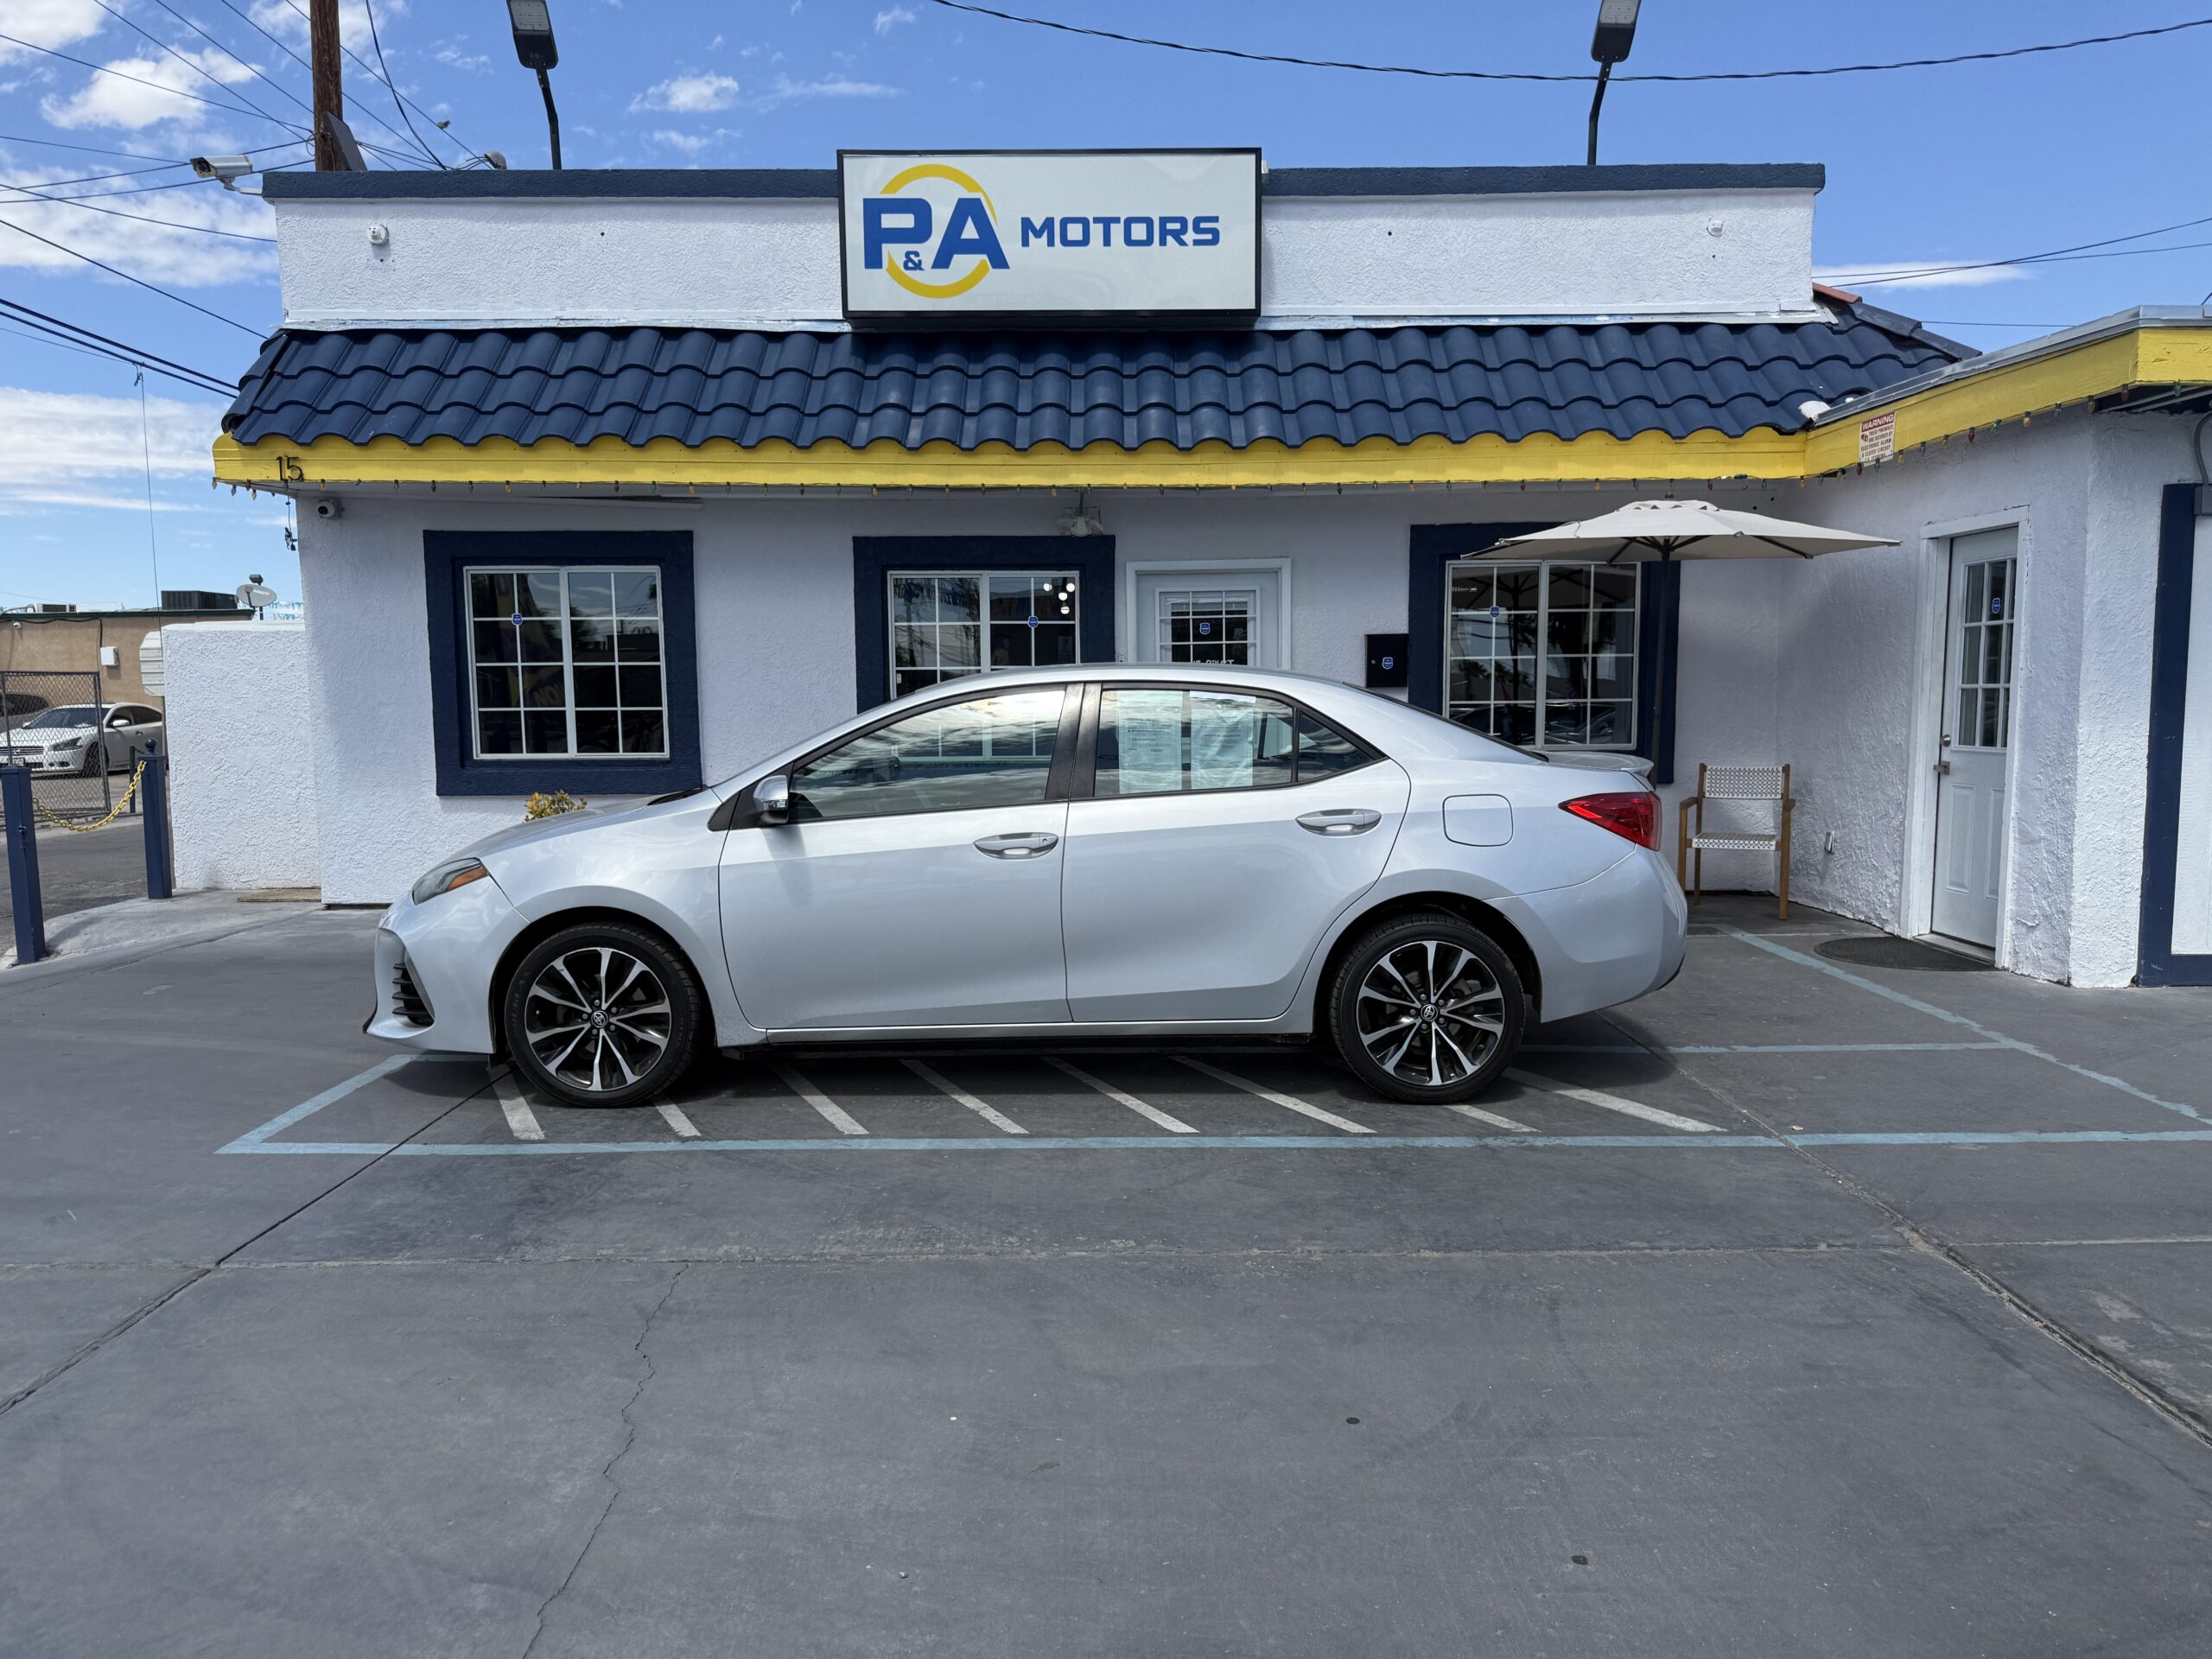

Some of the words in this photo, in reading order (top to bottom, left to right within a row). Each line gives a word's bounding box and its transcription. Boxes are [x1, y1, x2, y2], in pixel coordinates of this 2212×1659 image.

[862, 198, 1010, 271] P&A
[1020, 215, 1220, 248] MOTORS
[1862, 414, 1894, 431] WARNING
[276, 456, 303, 481] 15
